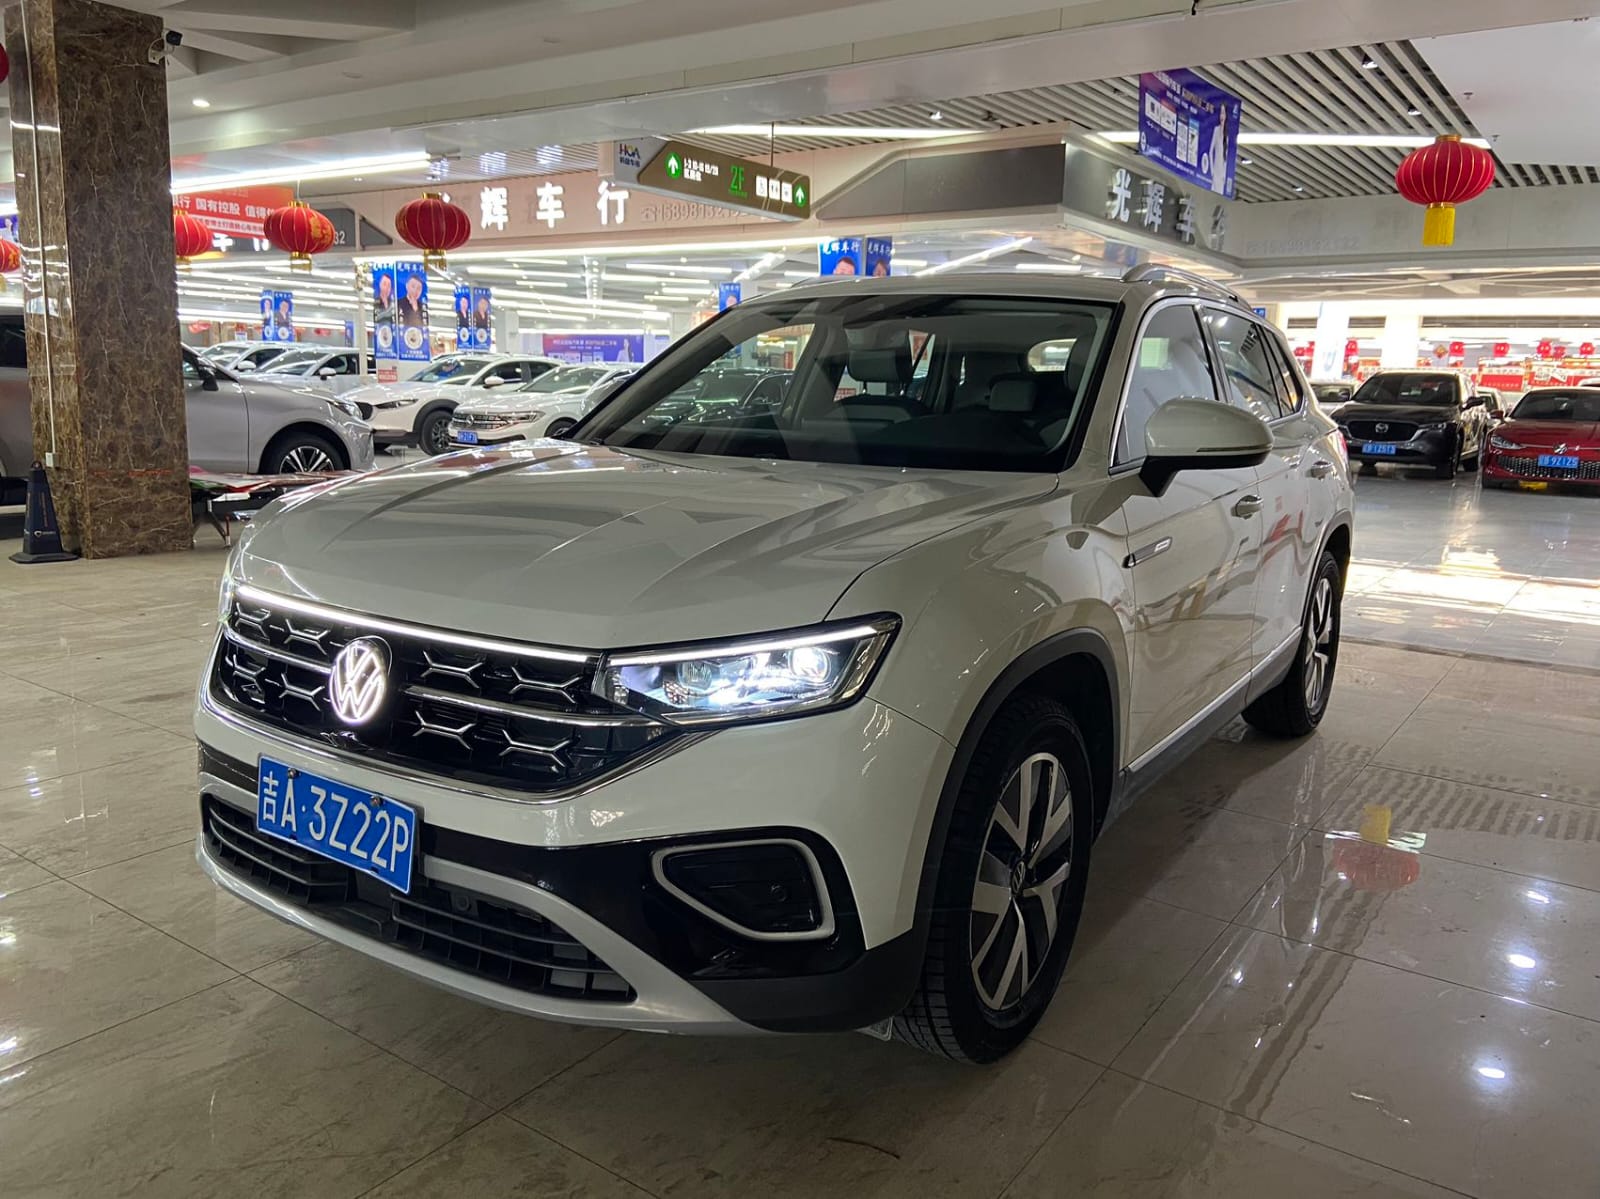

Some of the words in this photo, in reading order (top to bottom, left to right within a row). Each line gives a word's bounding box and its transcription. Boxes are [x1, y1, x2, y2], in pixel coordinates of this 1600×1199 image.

[730, 164, 745, 191] 2F
[480, 181, 629, 231] 辉车行
